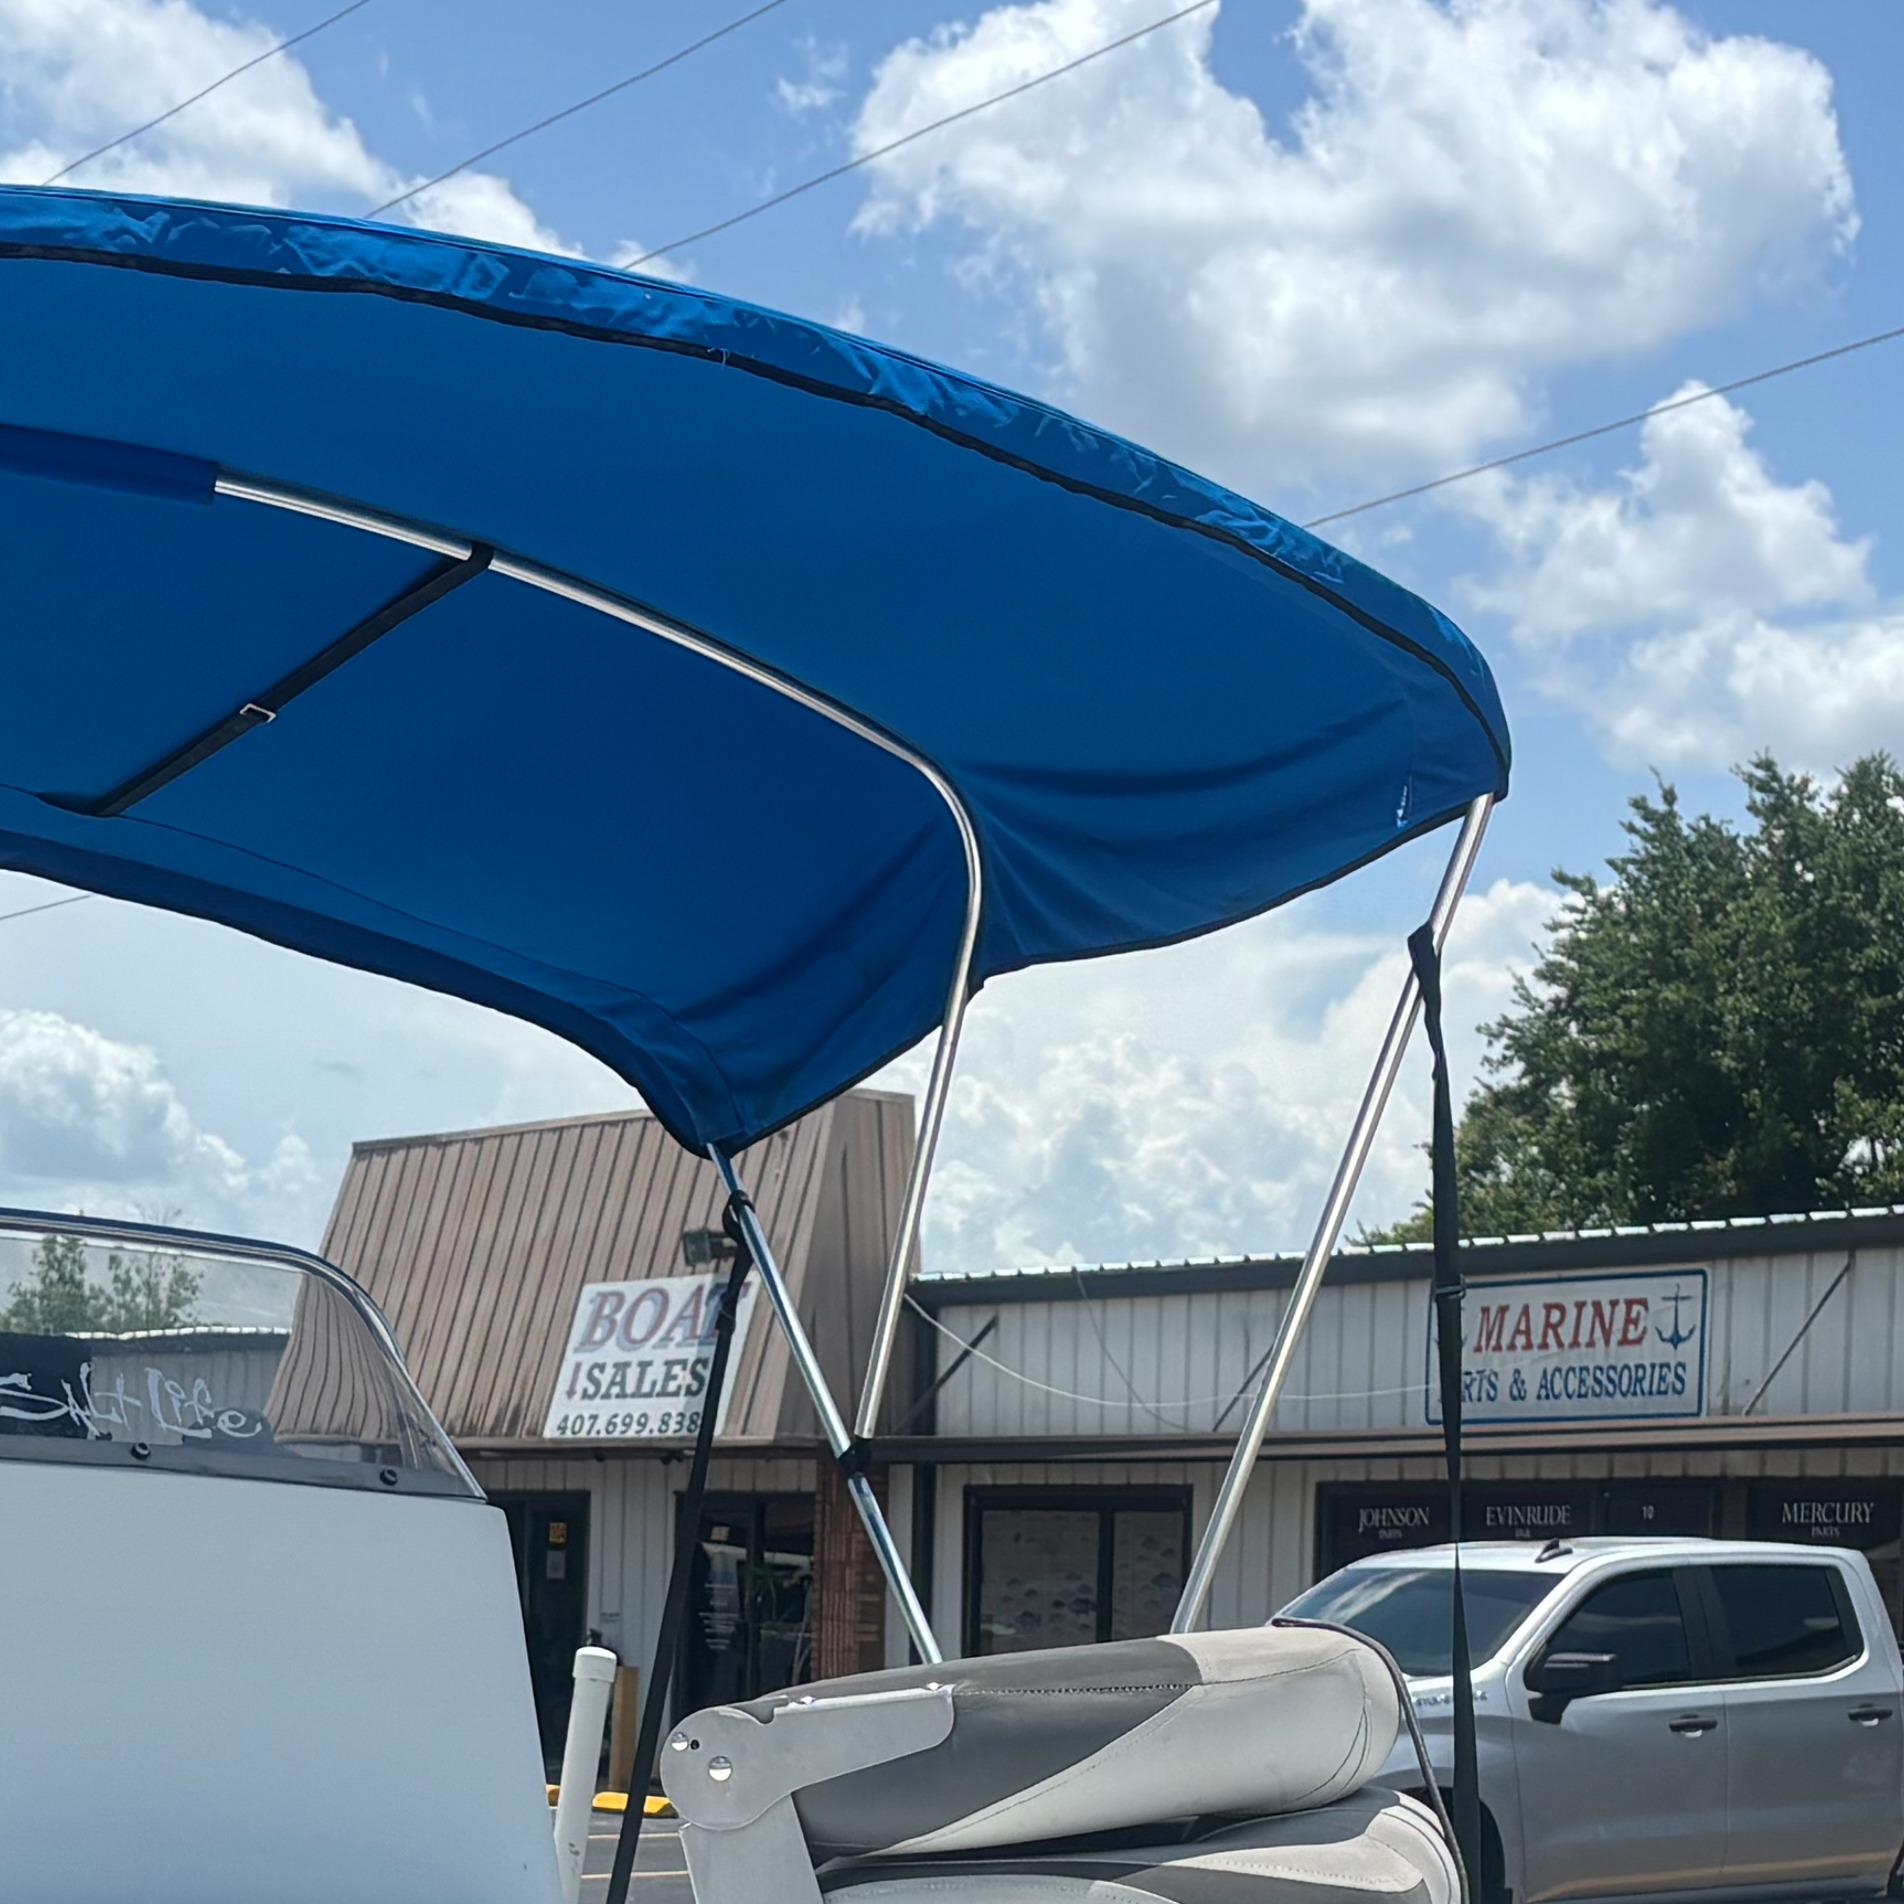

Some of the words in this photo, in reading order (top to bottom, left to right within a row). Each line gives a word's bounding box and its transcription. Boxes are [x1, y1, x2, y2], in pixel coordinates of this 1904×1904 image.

[1473, 1298, 1649, 1353] MARINE
[581, 1357, 710, 1400] SALES
[1509, 1367, 1527, 1402] &
[1536, 1361, 1688, 1400] ACCESSORIES
[557, 1411, 701, 1436] 407.699.838
[1358, 1506, 1430, 1533] JOHNSON
[1486, 1504, 1572, 1526] EVINRUDE
[1782, 1502, 1874, 1524] MERCURY
